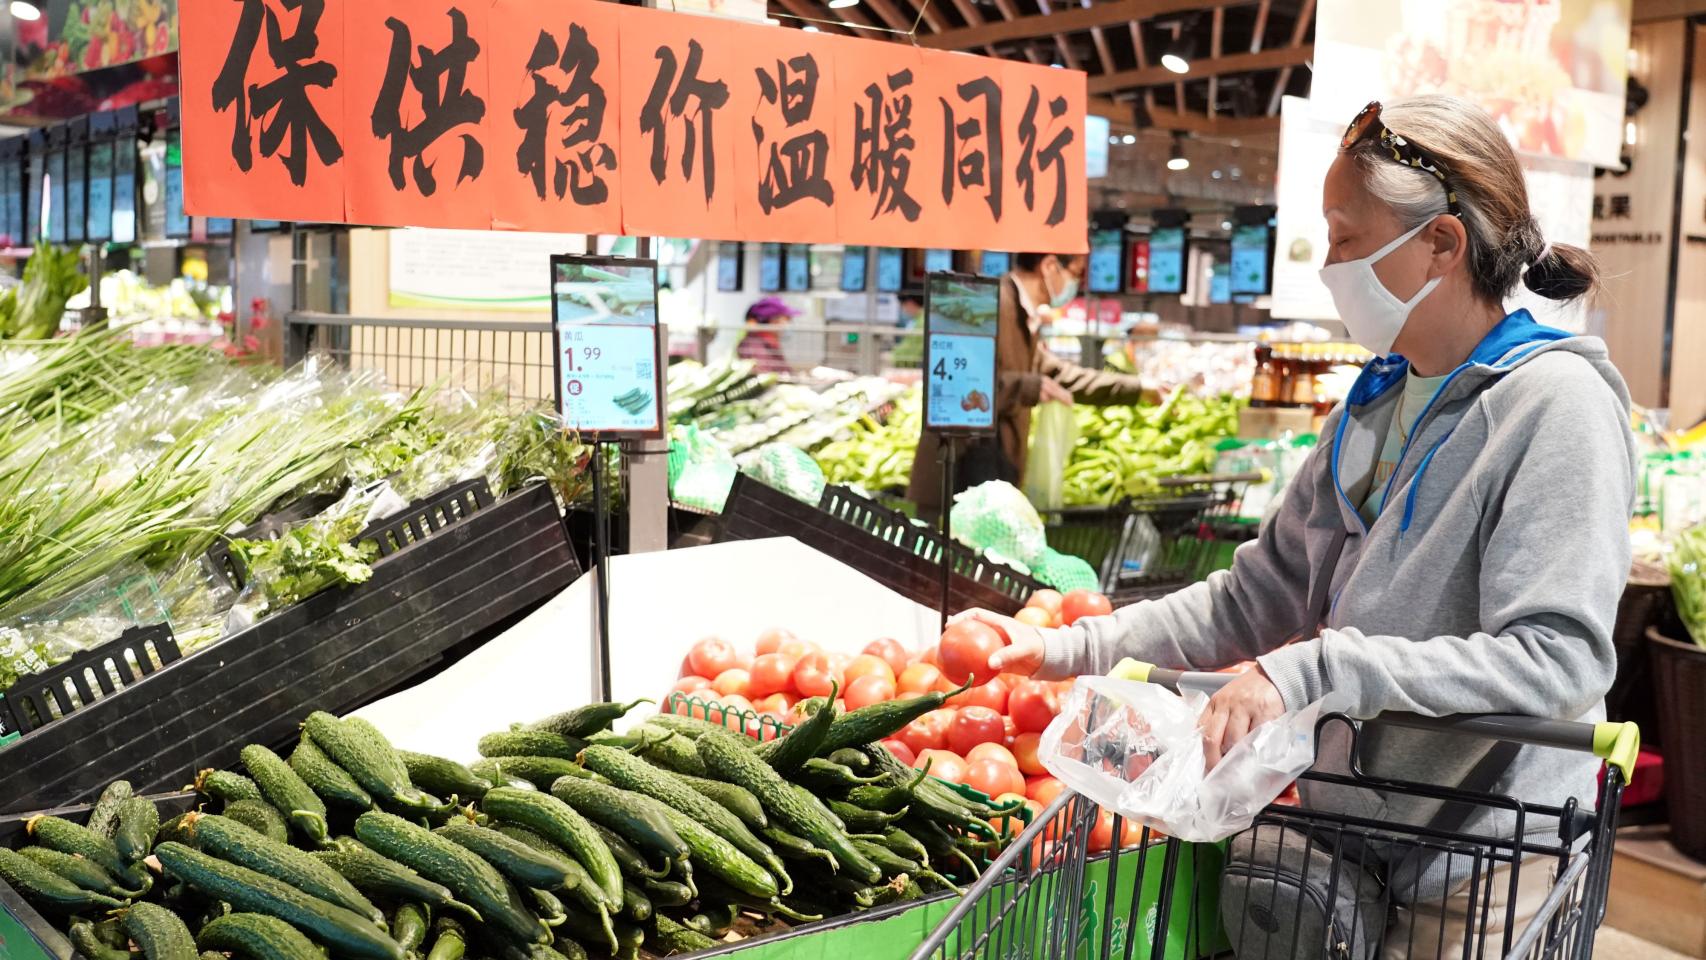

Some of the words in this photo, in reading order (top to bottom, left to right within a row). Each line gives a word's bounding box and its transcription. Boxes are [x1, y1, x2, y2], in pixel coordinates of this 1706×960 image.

[211, 0, 1074, 227] 保供稳价温暖同行
